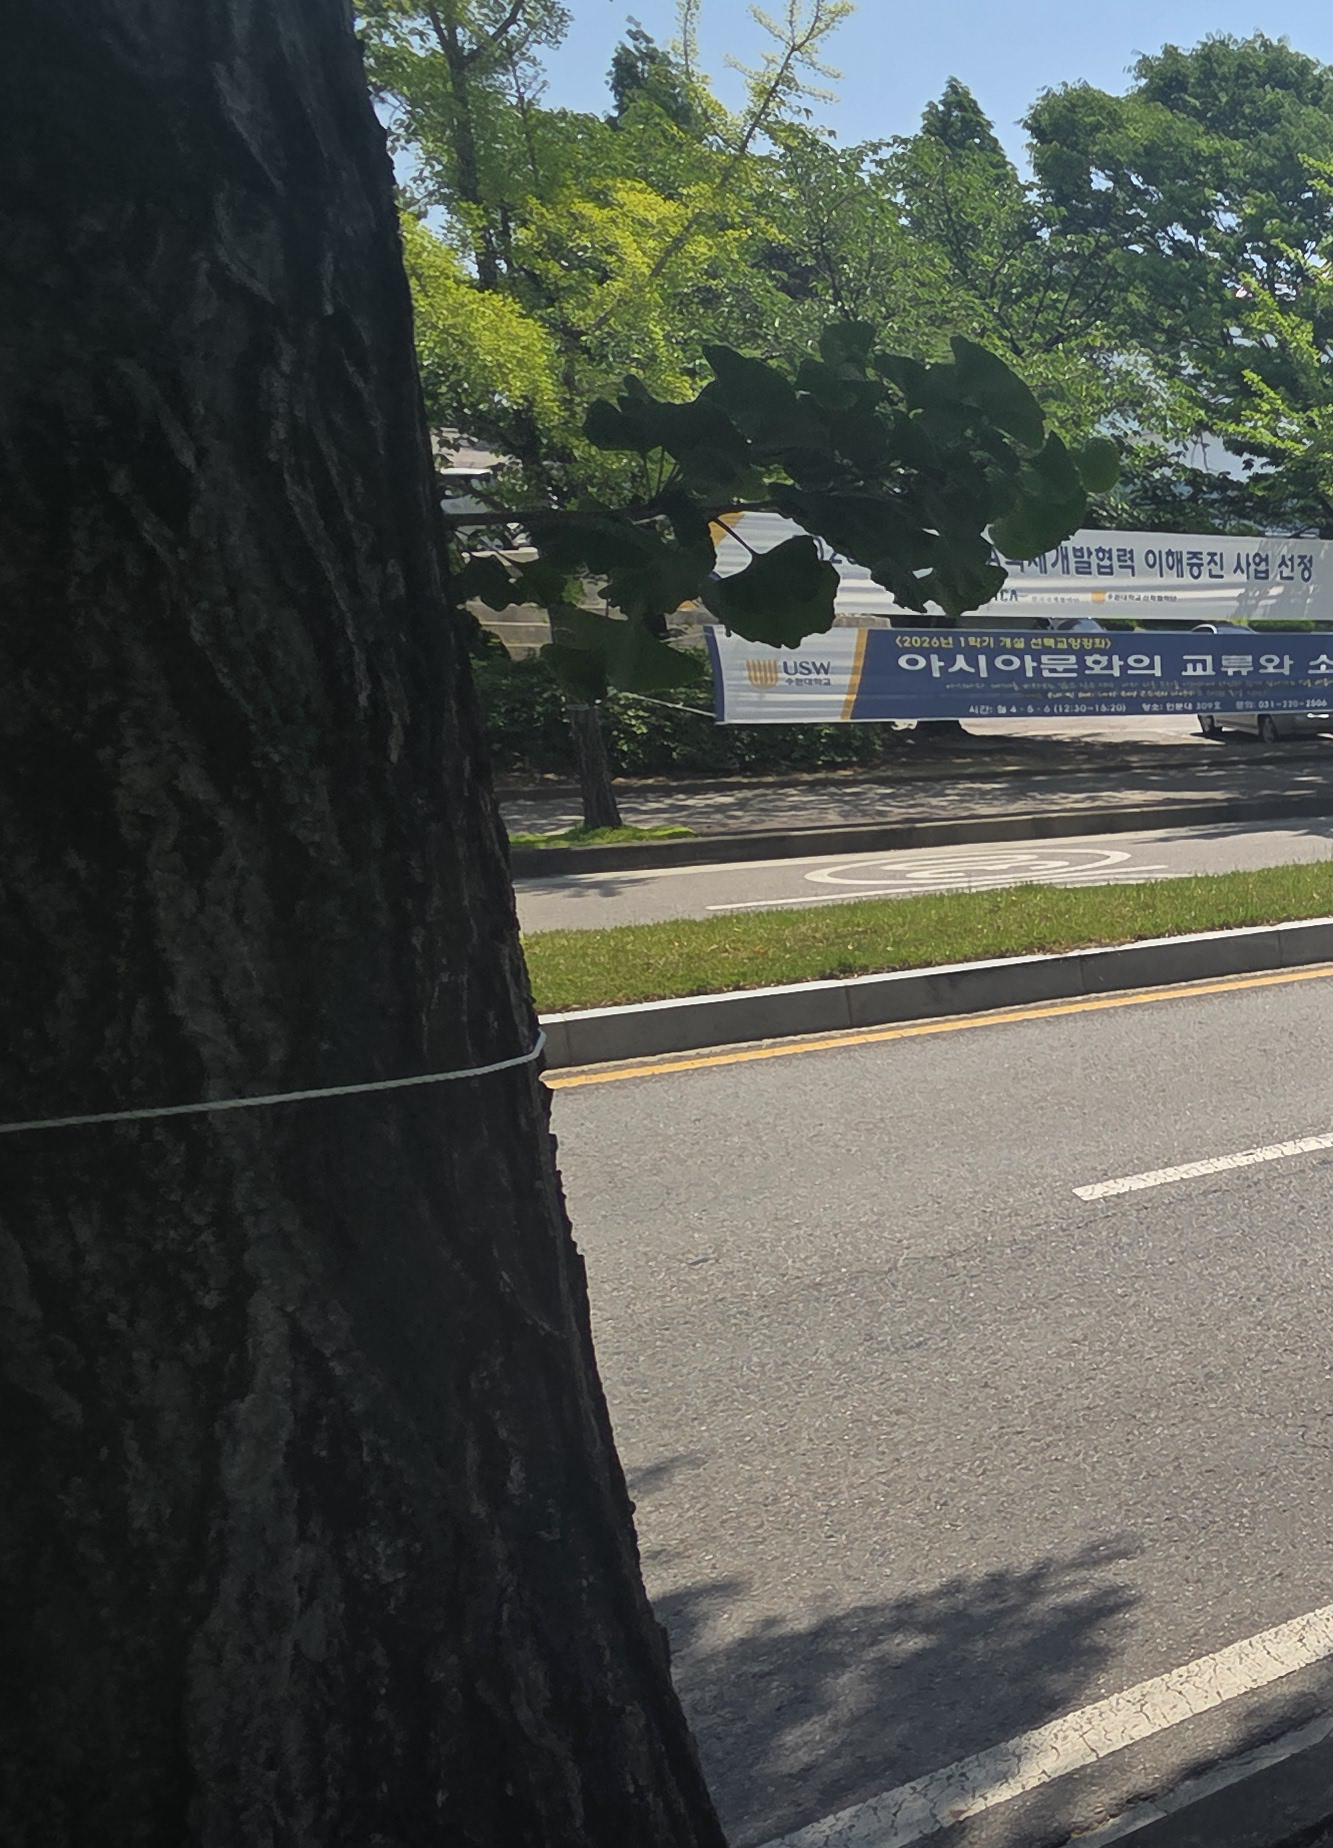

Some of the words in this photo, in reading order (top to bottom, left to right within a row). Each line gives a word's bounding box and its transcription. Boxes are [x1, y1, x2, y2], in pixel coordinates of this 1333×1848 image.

[1144, 549, 1225, 580] 이해증진
[1233, 551, 1270, 581] 사업
[1278, 554, 1313, 582] 선정
[999, 637, 1025, 649] 개설
[782, 660, 831, 676] USW
[897, 653, 1162, 678] 아시아문화의
[1181, 653, 1295, 676] 교류와
[784, 677, 831, 687] 수원대학교
[880, 854, 1070, 878] 30
